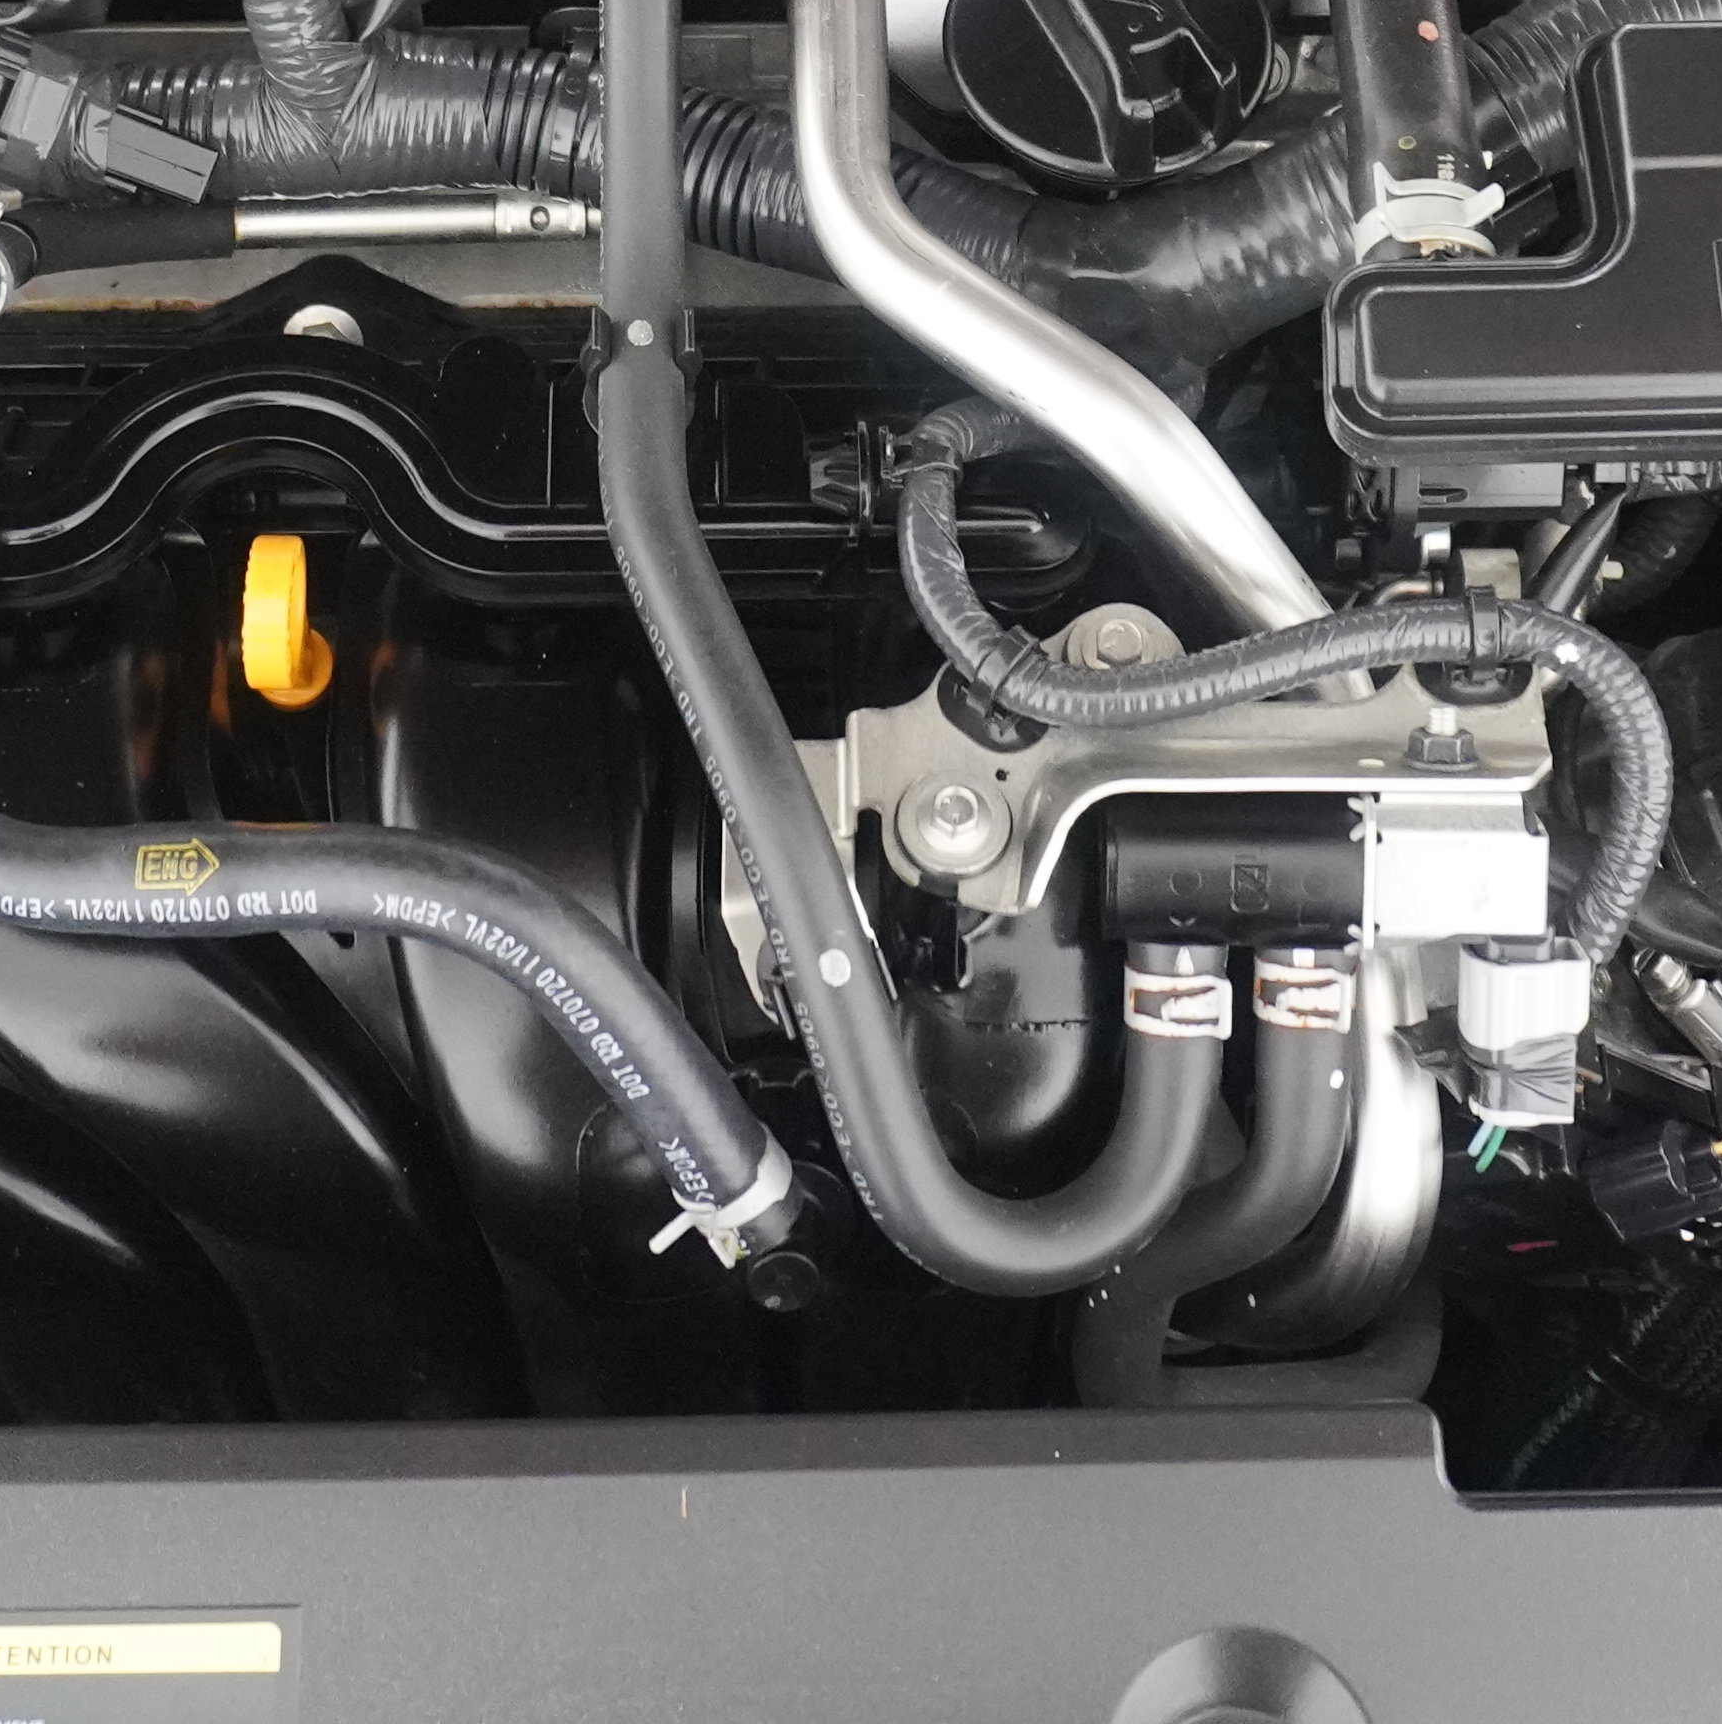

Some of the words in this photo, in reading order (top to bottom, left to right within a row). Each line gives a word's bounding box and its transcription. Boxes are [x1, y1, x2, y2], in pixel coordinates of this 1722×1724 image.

[150, 896, 230, 924] 070720
[280, 889, 318, 915] DOT
[535, 967, 600, 1035] 070720
[611, 1064, 650, 1100] DOT
